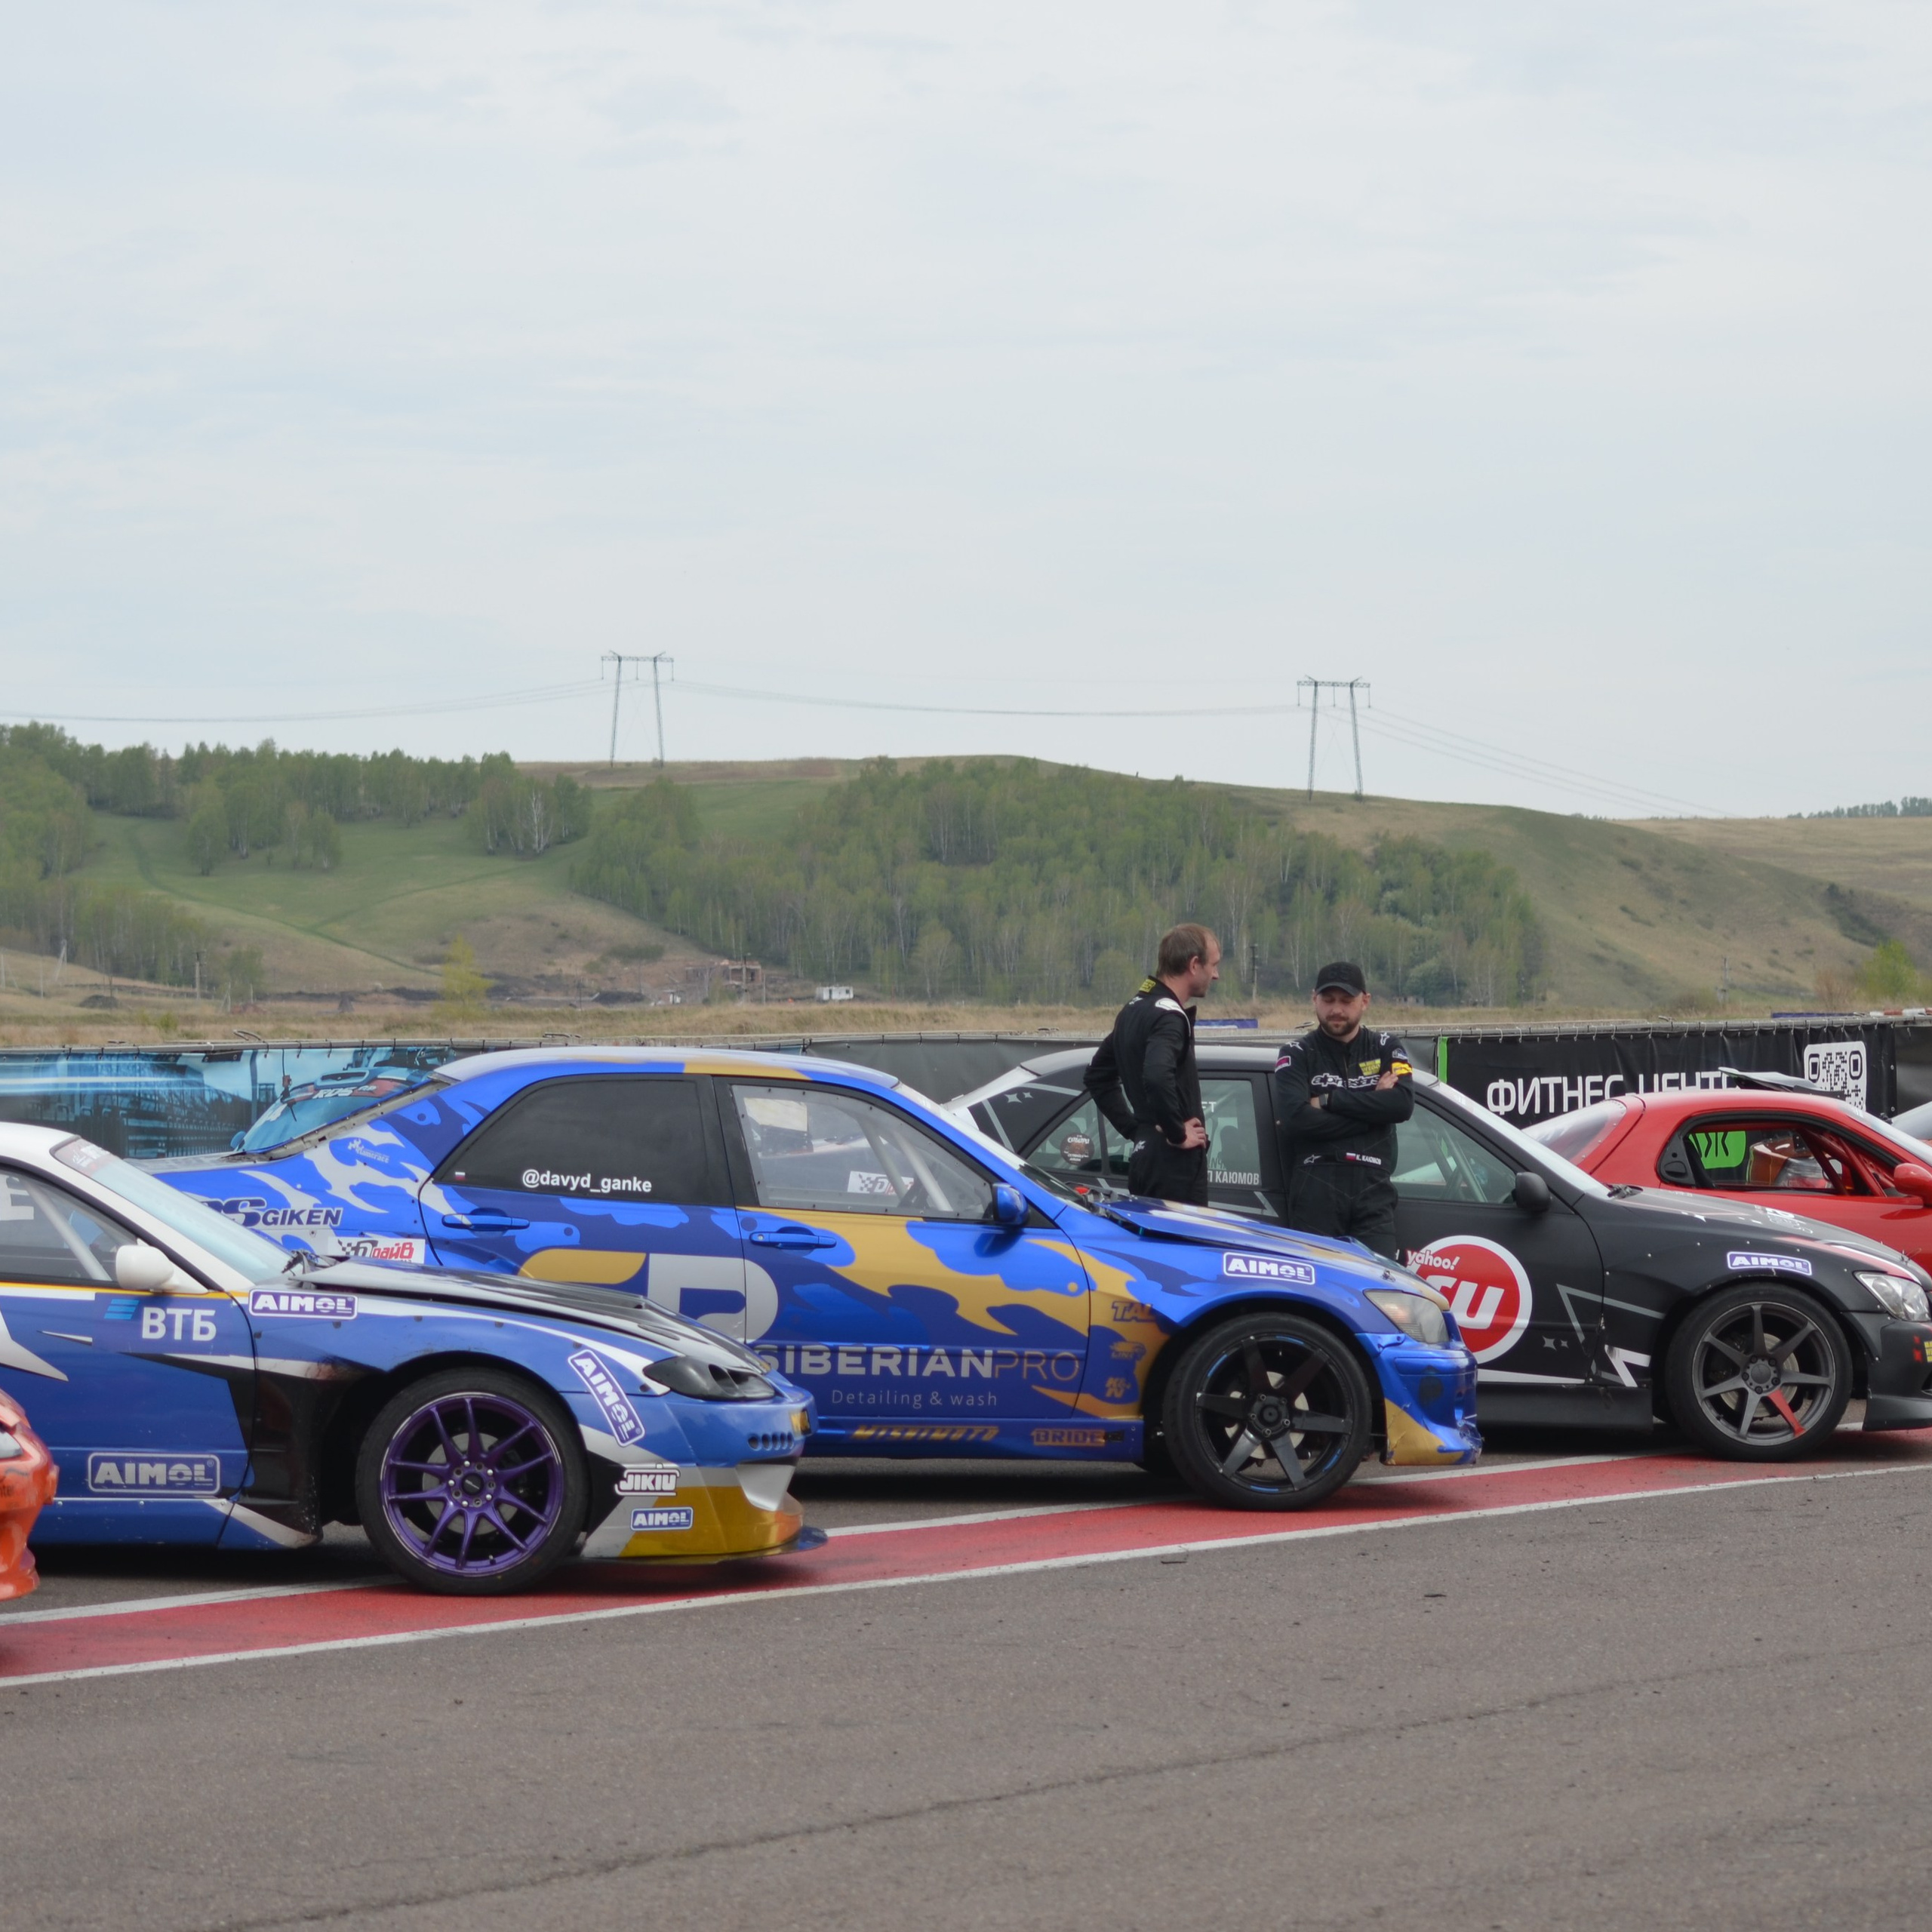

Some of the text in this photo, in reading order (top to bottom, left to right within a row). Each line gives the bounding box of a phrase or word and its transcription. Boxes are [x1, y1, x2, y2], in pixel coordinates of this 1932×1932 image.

[522, 1169, 652, 1193] @davyd_ganke
[1215, 1171, 1260, 1186] КАЮМОВ
[262, 1209, 342, 1226] GIKEN
[1228, 1258, 1311, 1281] AIMOL
[1407, 1250, 1460, 1270] yahoo!
[1732, 1256, 1808, 1272] AIMOL
[254, 1294, 352, 1314] AIMOL
[142, 1306, 217, 1341] ВТБ
[574, 1358, 635, 1441] AIMOL
[832, 1389, 997, 1409] Detailing & wash
[1035, 1430, 1105, 1443] BRIDE
[94, 1462, 214, 1486] AIMOL
[620, 1474, 677, 1491] JIKIU
[633, 1512, 690, 1526] AIMOL
